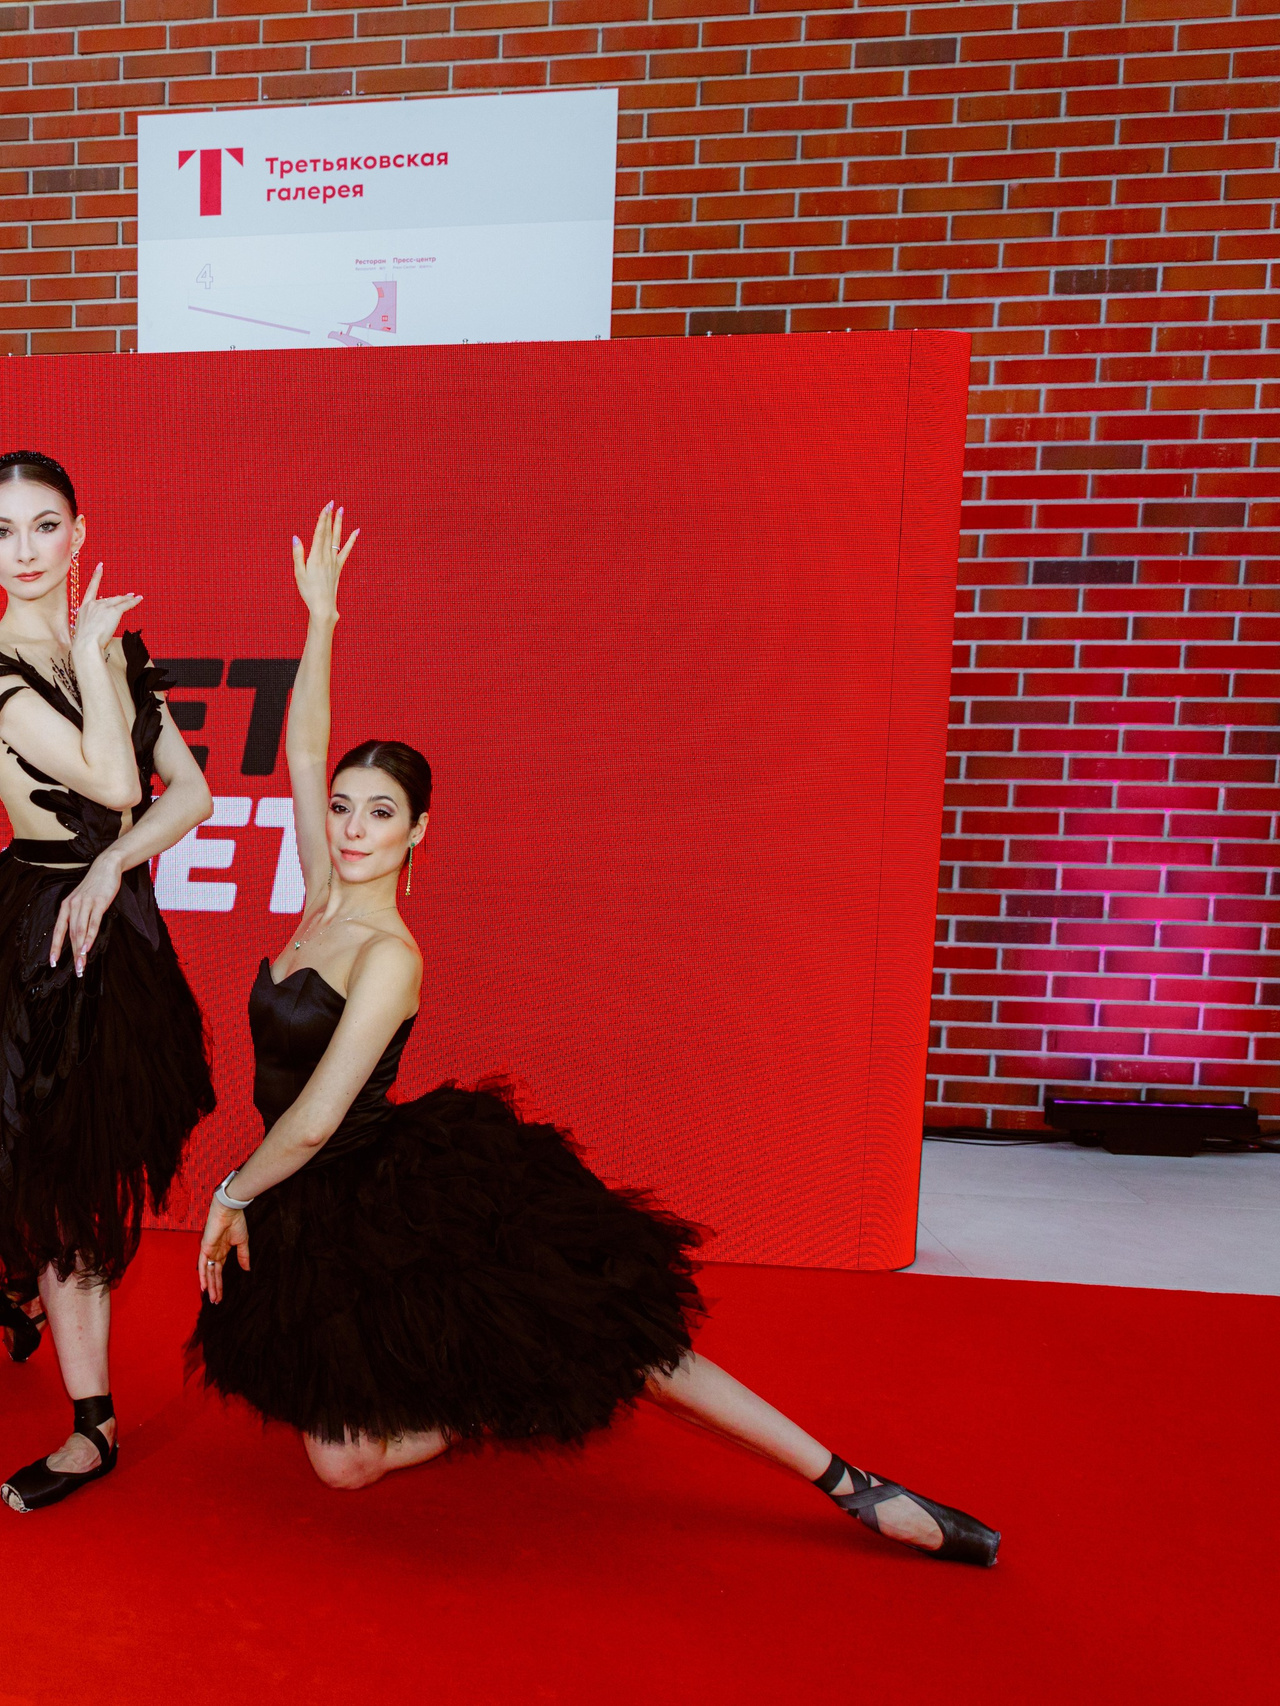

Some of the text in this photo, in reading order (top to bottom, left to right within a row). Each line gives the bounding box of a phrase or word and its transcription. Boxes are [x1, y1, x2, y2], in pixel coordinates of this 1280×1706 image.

[265, 151, 449, 178] Третьяковская
[267, 183, 363, 204] галерея
[195, 263, 215, 290] 4
